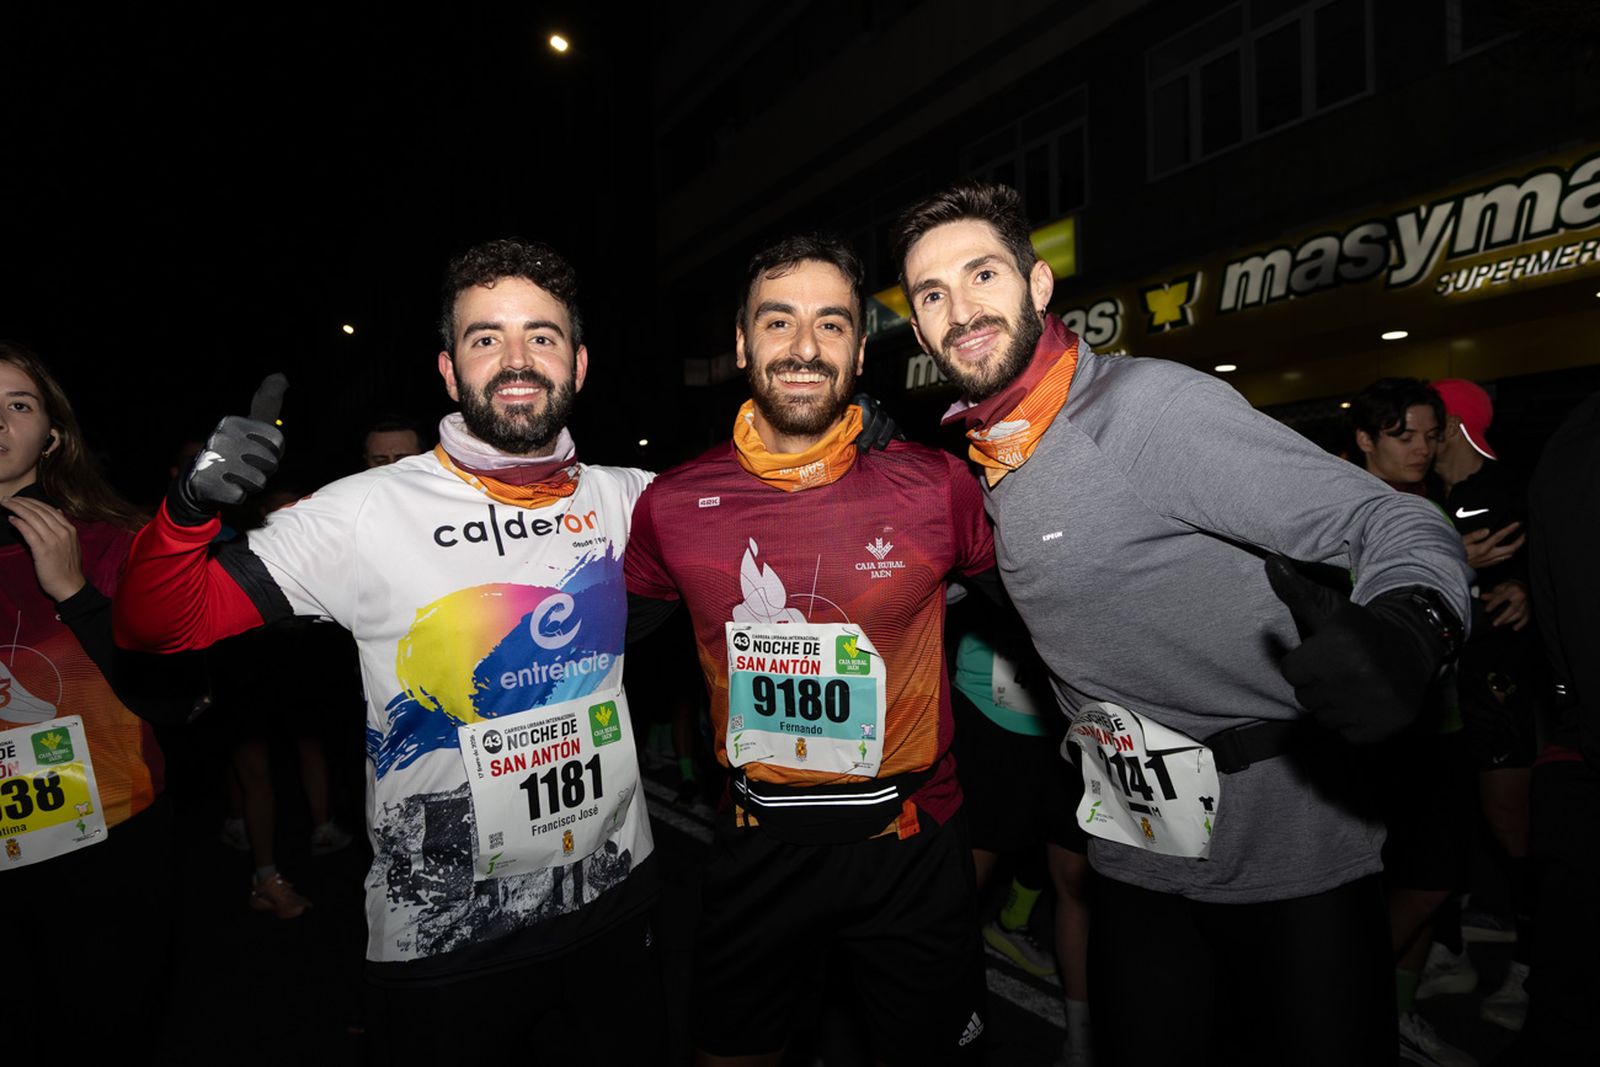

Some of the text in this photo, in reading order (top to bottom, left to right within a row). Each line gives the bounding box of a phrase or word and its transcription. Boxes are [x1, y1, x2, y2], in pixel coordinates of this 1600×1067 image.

[433, 504, 599, 556] calderon
[878, 561, 906, 569] RURAL
[734, 636, 749, 646] 43
[753, 640, 821, 656] NOCHE DE
[500, 651, 610, 690] entrénate
[736, 656, 821, 675] SAN ANTÓN
[752, 675, 850, 723] 9180
[504, 712, 576, 735] CARRERA URBANA INTERNACIONAL
[507, 719, 578, 751] NOCHE DE
[779, 722, 823, 735] Fernando
[484, 734, 501, 748] 43
[490, 736, 581, 777] SAN ANTÓN
[0, 771, 65, 822] 38
[519, 753, 604, 821] 1181
[531, 805, 599, 837] Francisco José
